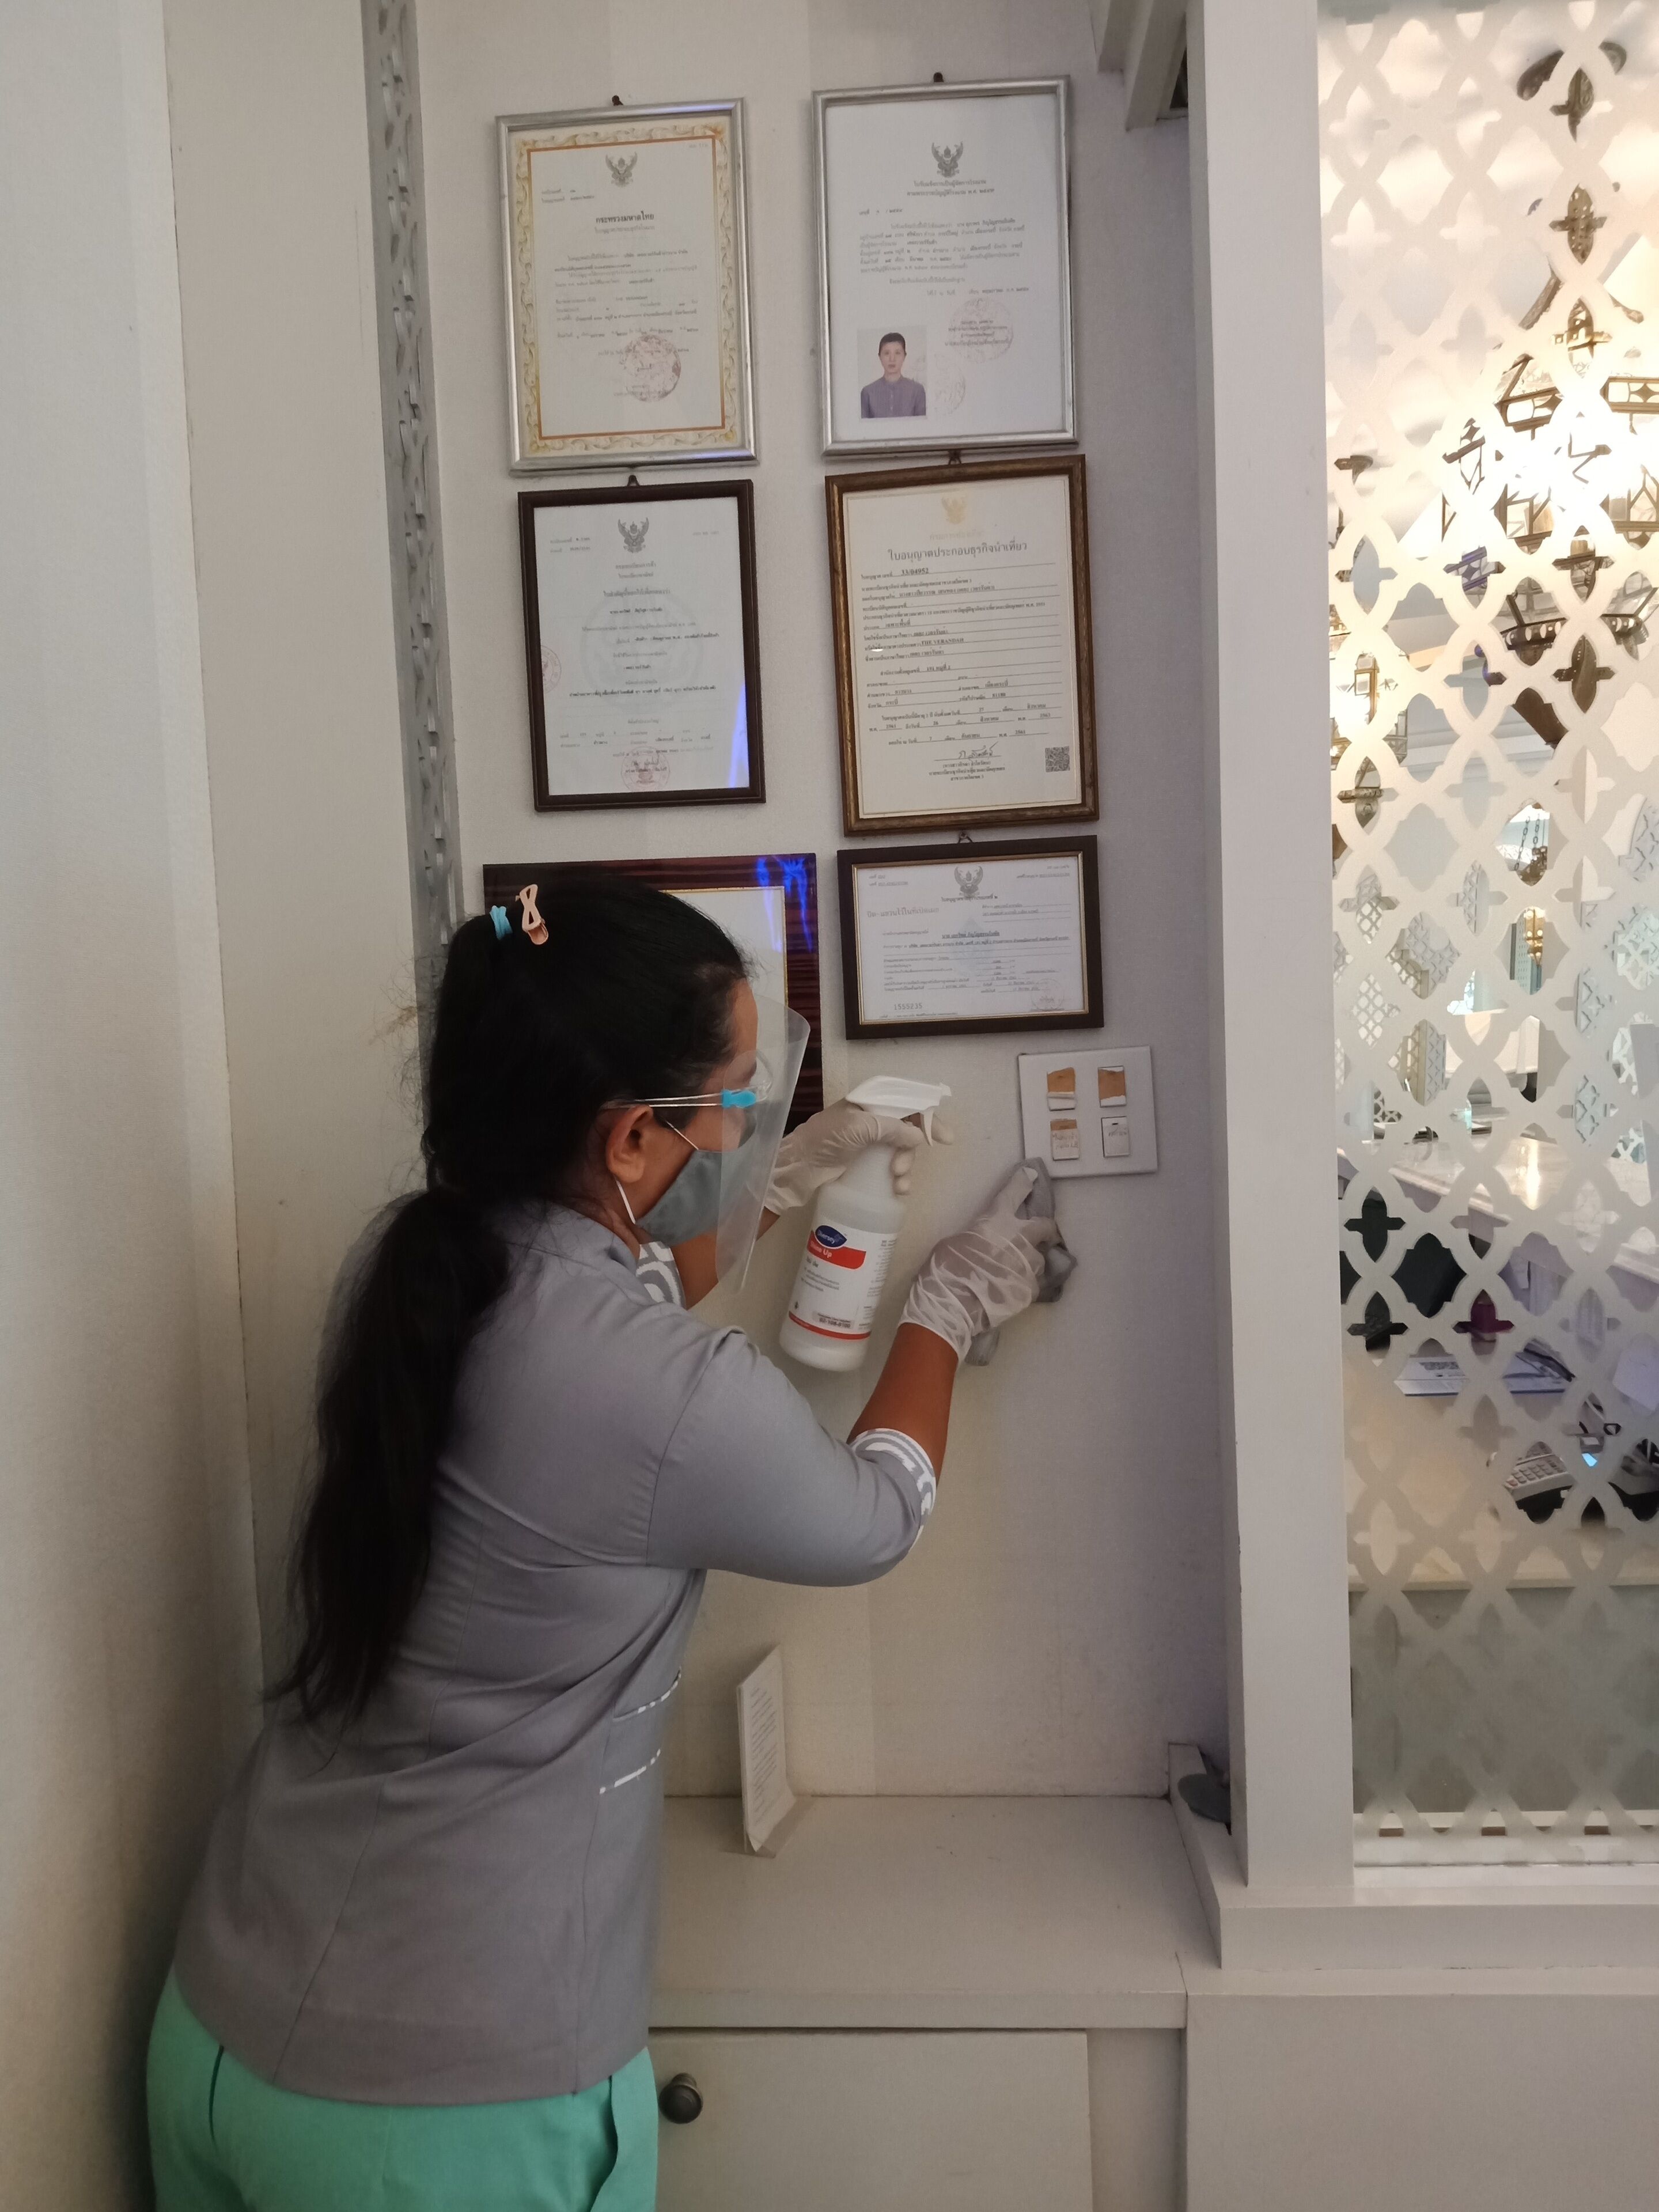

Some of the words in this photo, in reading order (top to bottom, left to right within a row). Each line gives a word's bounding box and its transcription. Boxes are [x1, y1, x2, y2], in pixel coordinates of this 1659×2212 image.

[596, 210, 654, 224] กระทรวงมหาดไทย
[888, 536, 1027, 562] ใบอนุญาตประกอบธุรกิจนำเที่ยว
[901, 567, 929, 575] 33/04952
[823, 1248, 832, 1258] Up
